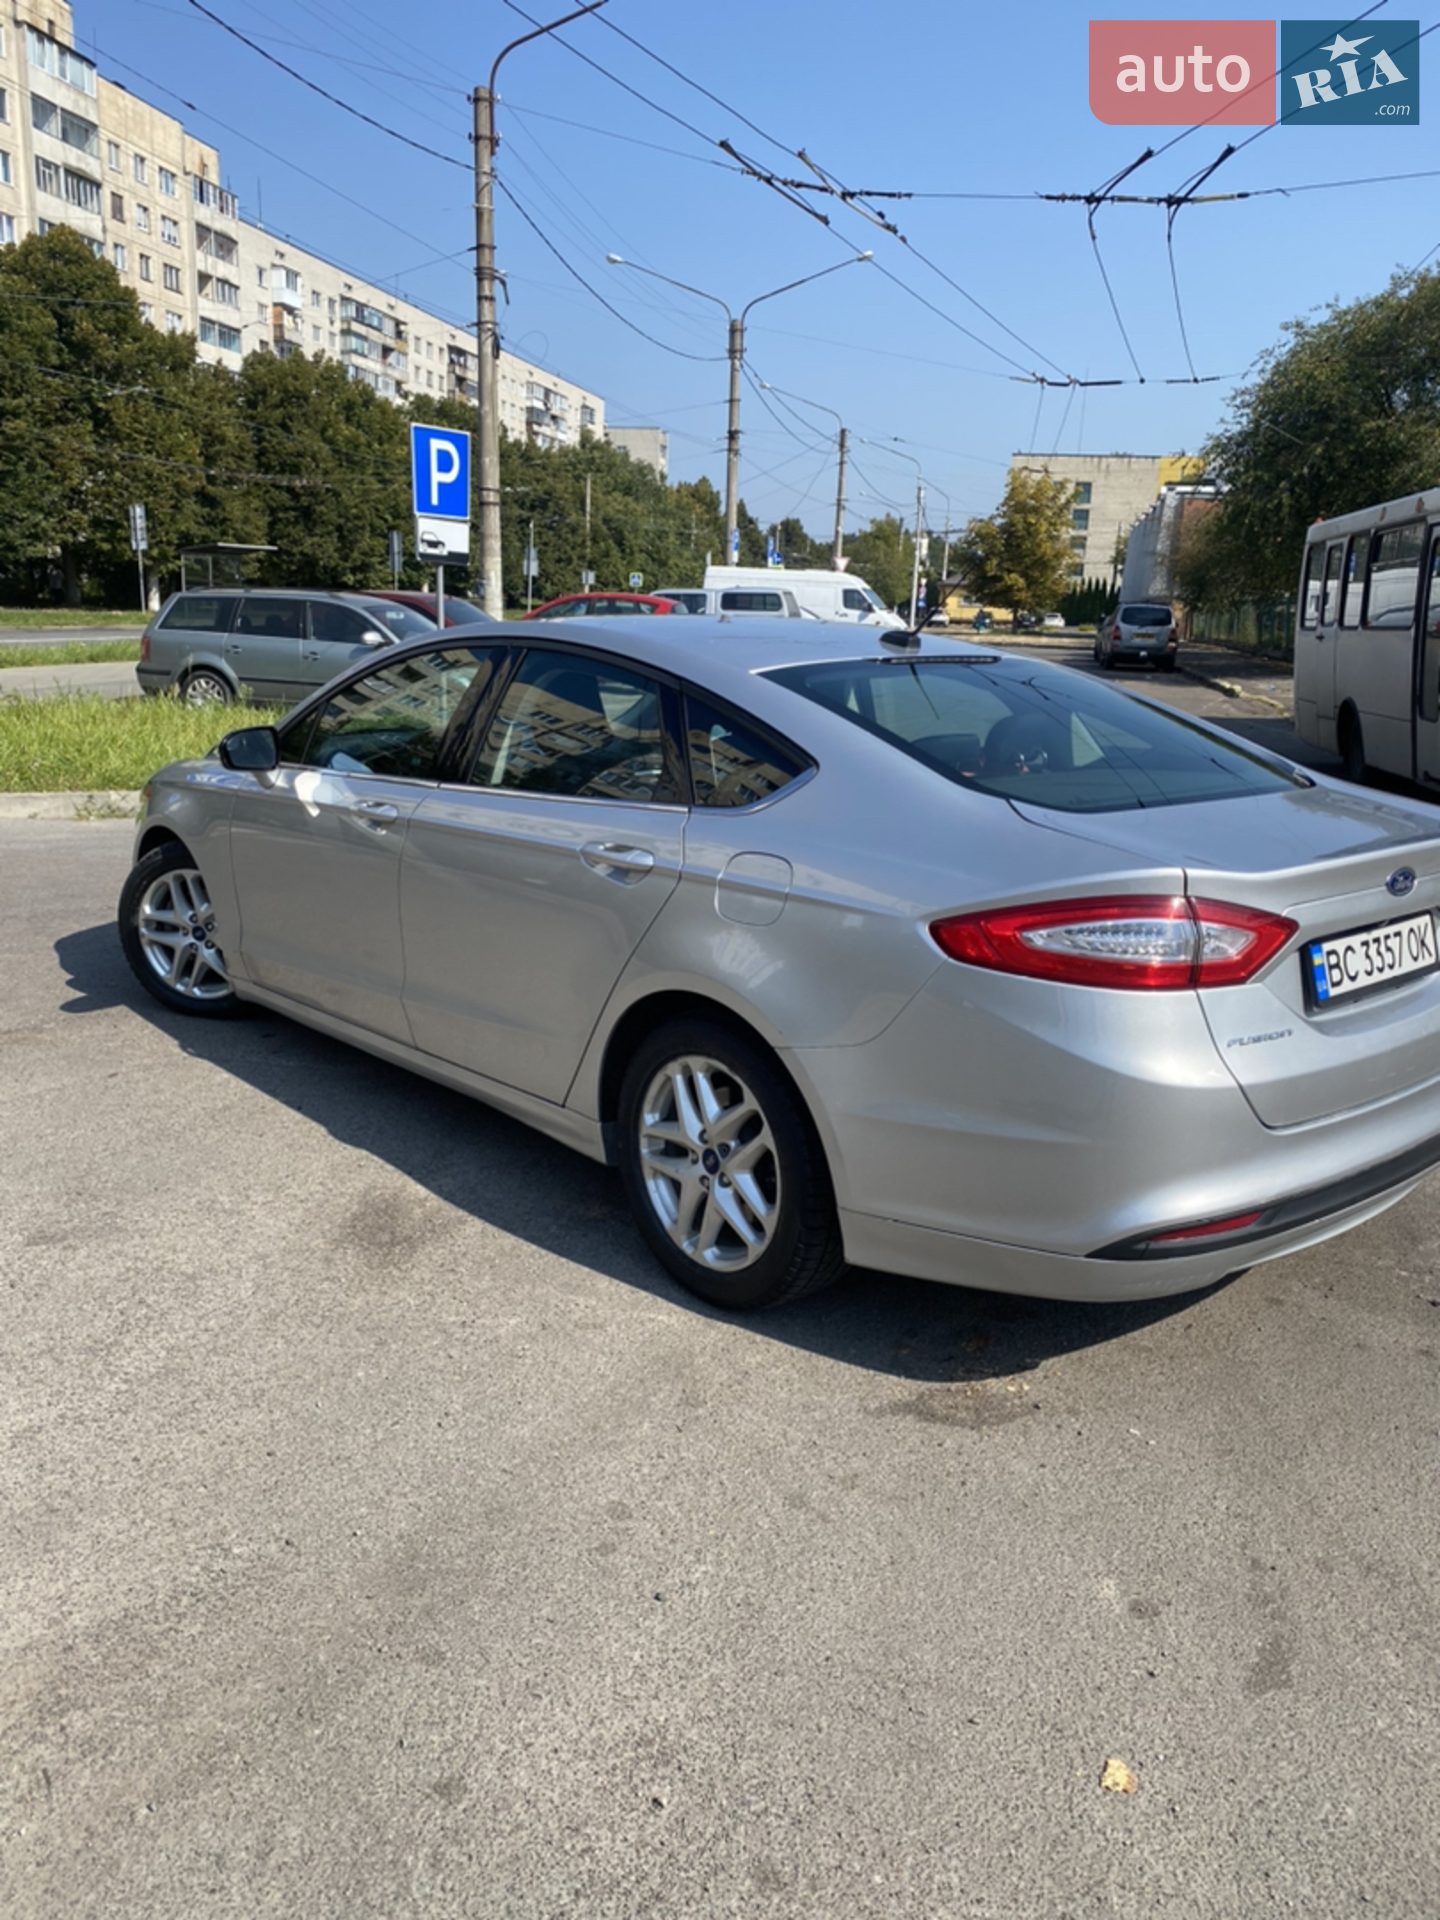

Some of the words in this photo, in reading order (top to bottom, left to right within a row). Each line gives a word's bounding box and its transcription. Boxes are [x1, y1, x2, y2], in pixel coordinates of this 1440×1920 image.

[429, 437, 460, 506] P
[1326, 944, 1359, 988] BC
[1360, 930, 1403, 976] 3357
[1407, 922, 1433, 962] OK
